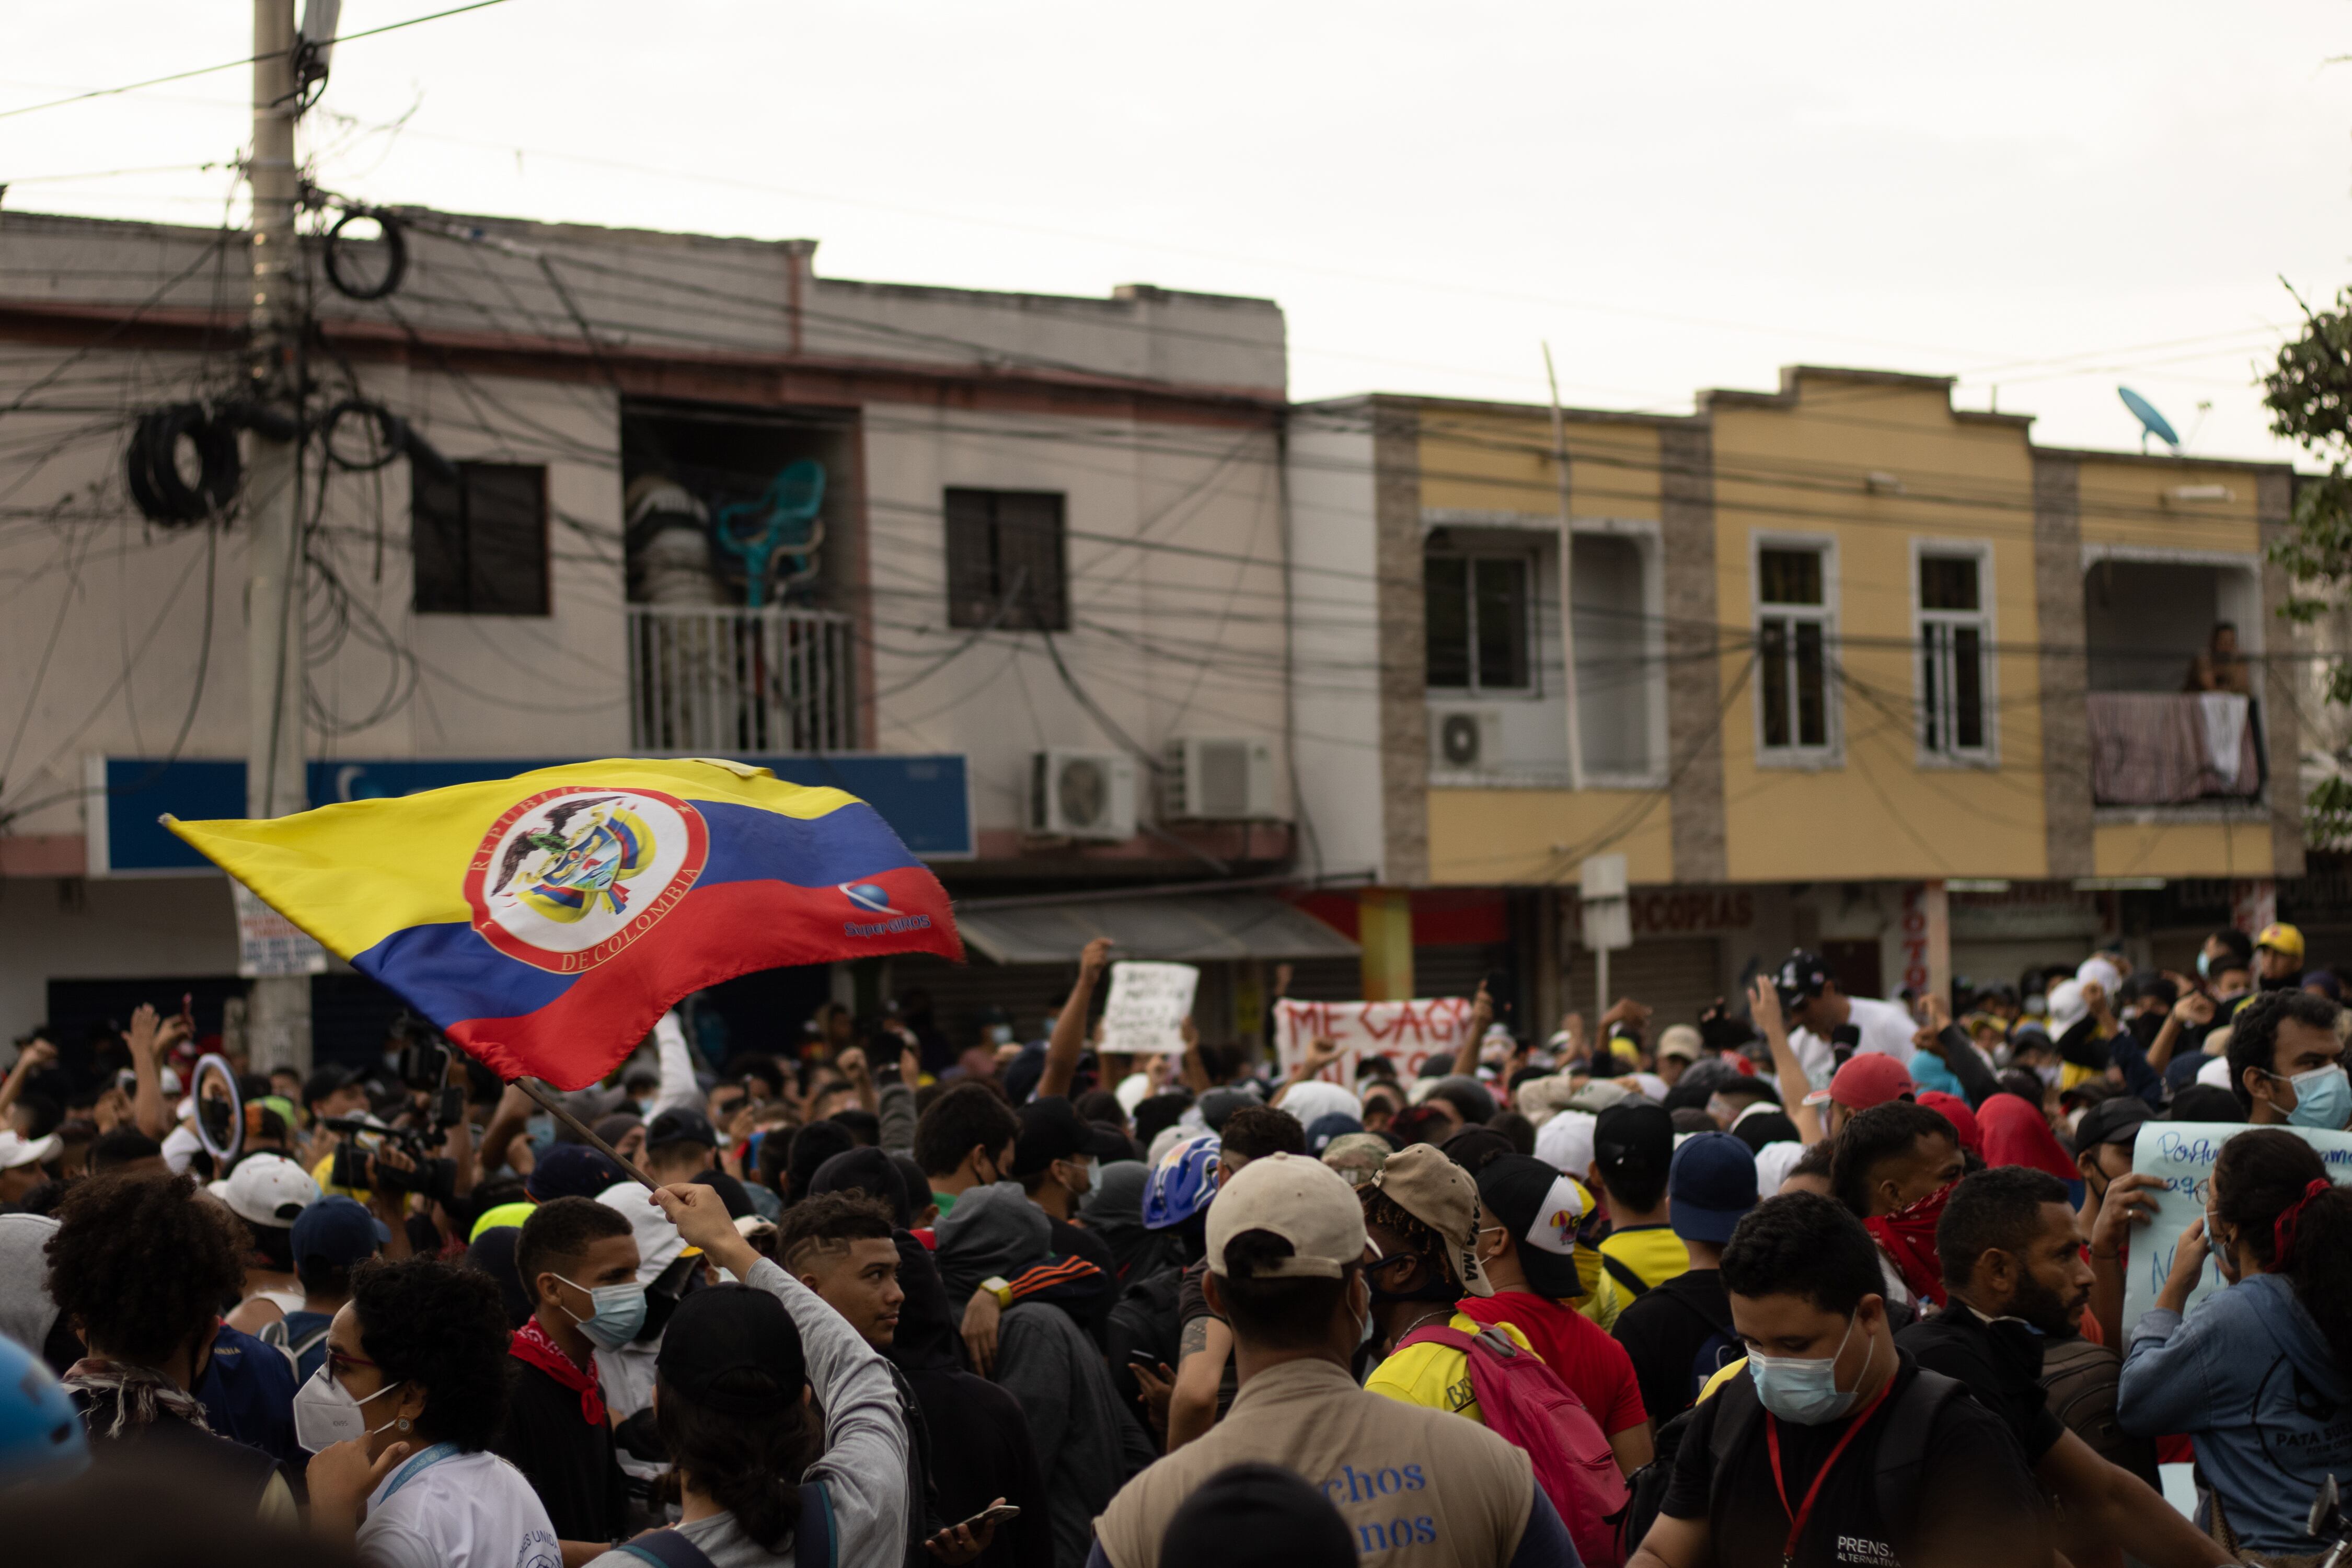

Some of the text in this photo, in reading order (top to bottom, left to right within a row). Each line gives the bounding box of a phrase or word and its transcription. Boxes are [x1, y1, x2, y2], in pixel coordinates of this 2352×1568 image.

[561, 868, 698, 971] DE COLOMBIA
[1560, 892, 1753, 930] FOCOPIAS
[1288, 1000, 1353, 1047] ME
[2157, 1130, 2219, 1166] Porqu
[1463, 1195, 1480, 1281] ANAMA
[2276, 1431, 2320, 1447] PATA
[401, 1458, 426, 1481] UNIDAS
[1355, 1516, 1437, 1553] nos
